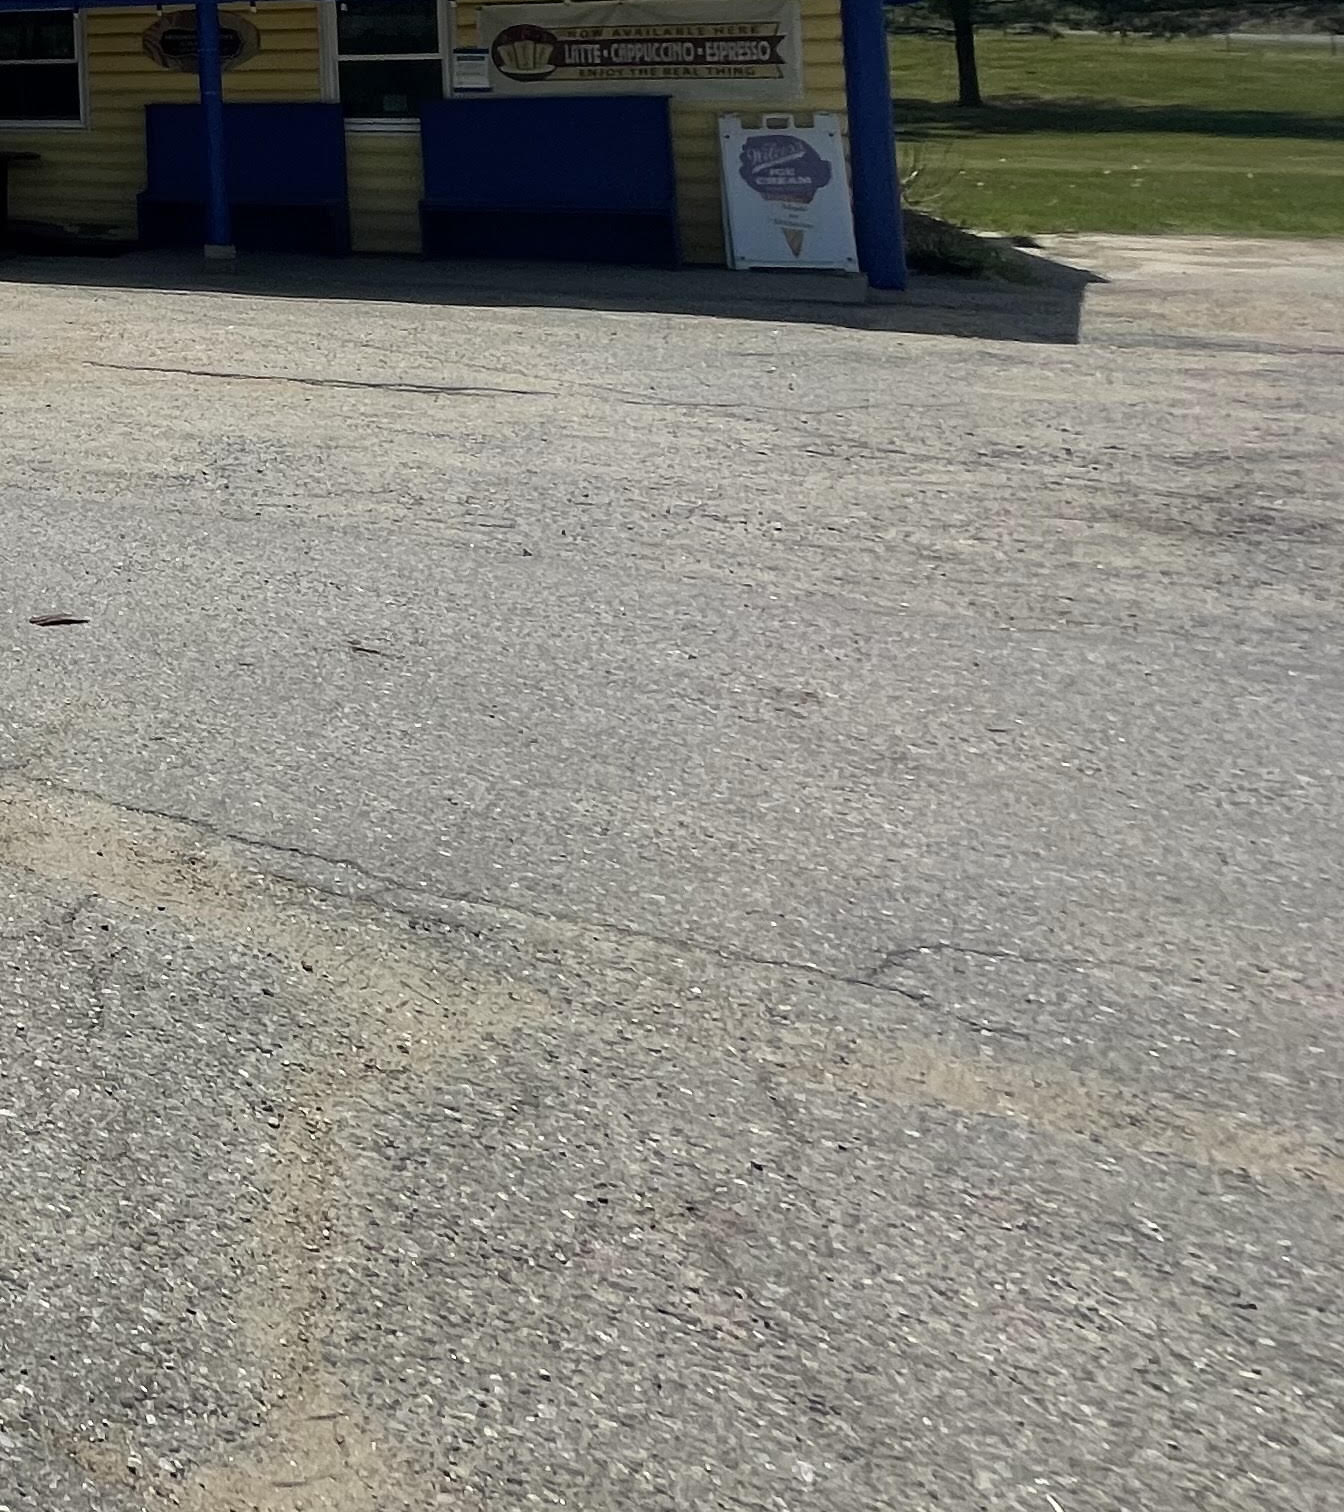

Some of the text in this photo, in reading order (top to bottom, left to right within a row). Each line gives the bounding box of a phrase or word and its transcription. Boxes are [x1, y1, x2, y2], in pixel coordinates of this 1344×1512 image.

[567, 25, 762, 38] NOW AVAILABLE HERE
[564, 40, 771, 64] LATTE CAPPUCCINO ESPRESSO
[579, 66, 757, 77] ENJOY THE REAL THING
[769, 168, 796, 177] ICE
[755, 176, 813, 185] CREAM
